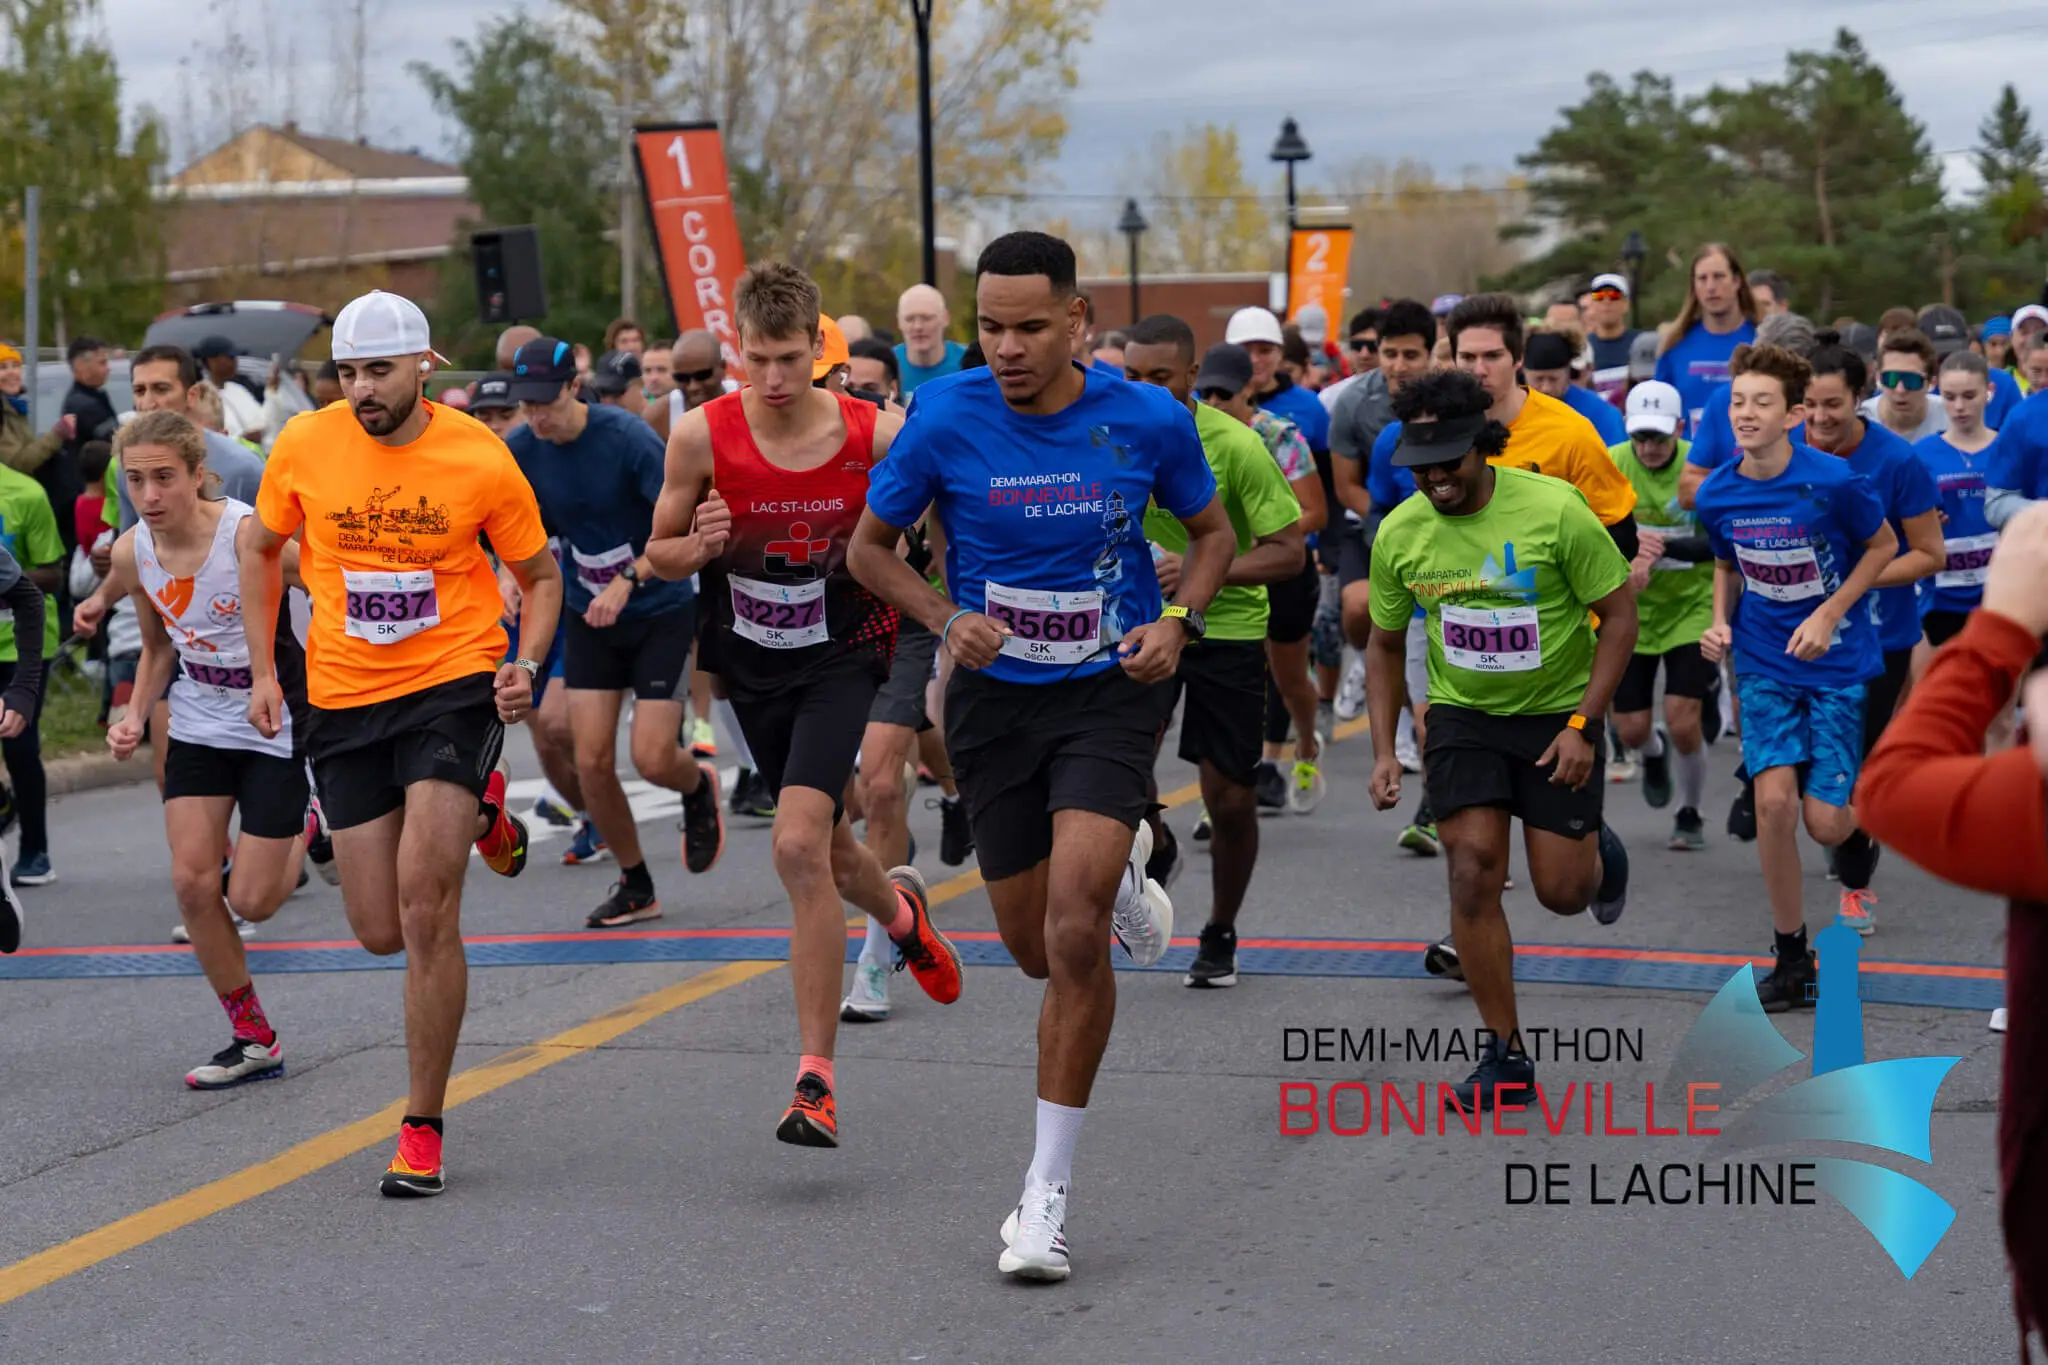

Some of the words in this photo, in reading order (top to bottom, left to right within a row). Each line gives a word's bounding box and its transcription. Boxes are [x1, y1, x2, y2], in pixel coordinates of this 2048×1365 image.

[667, 135, 693, 190] 1
[1306, 233, 1331, 272] 2
[990, 472, 1081, 488] DEMI-MARATHON
[989, 482, 1103, 506] BONNEVILLE
[750, 501, 778, 513] LAC
[781, 498, 844, 513] ST-LOUIS
[1025, 505, 1043, 518] DE
[1047, 500, 1103, 516] LACHINE
[347, 591, 431, 621] 3637
[739, 595, 817, 628] 3227
[377, 624, 397, 634] 5K
[766, 630, 785, 640] 5K
[760, 638, 793, 648] NICOLAS
[1450, 625, 1529, 652] 3010
[1030, 642, 1051, 653] 5K
[1024, 652, 1056, 662] OSCAR
[1480, 655, 1498, 663] 5K
